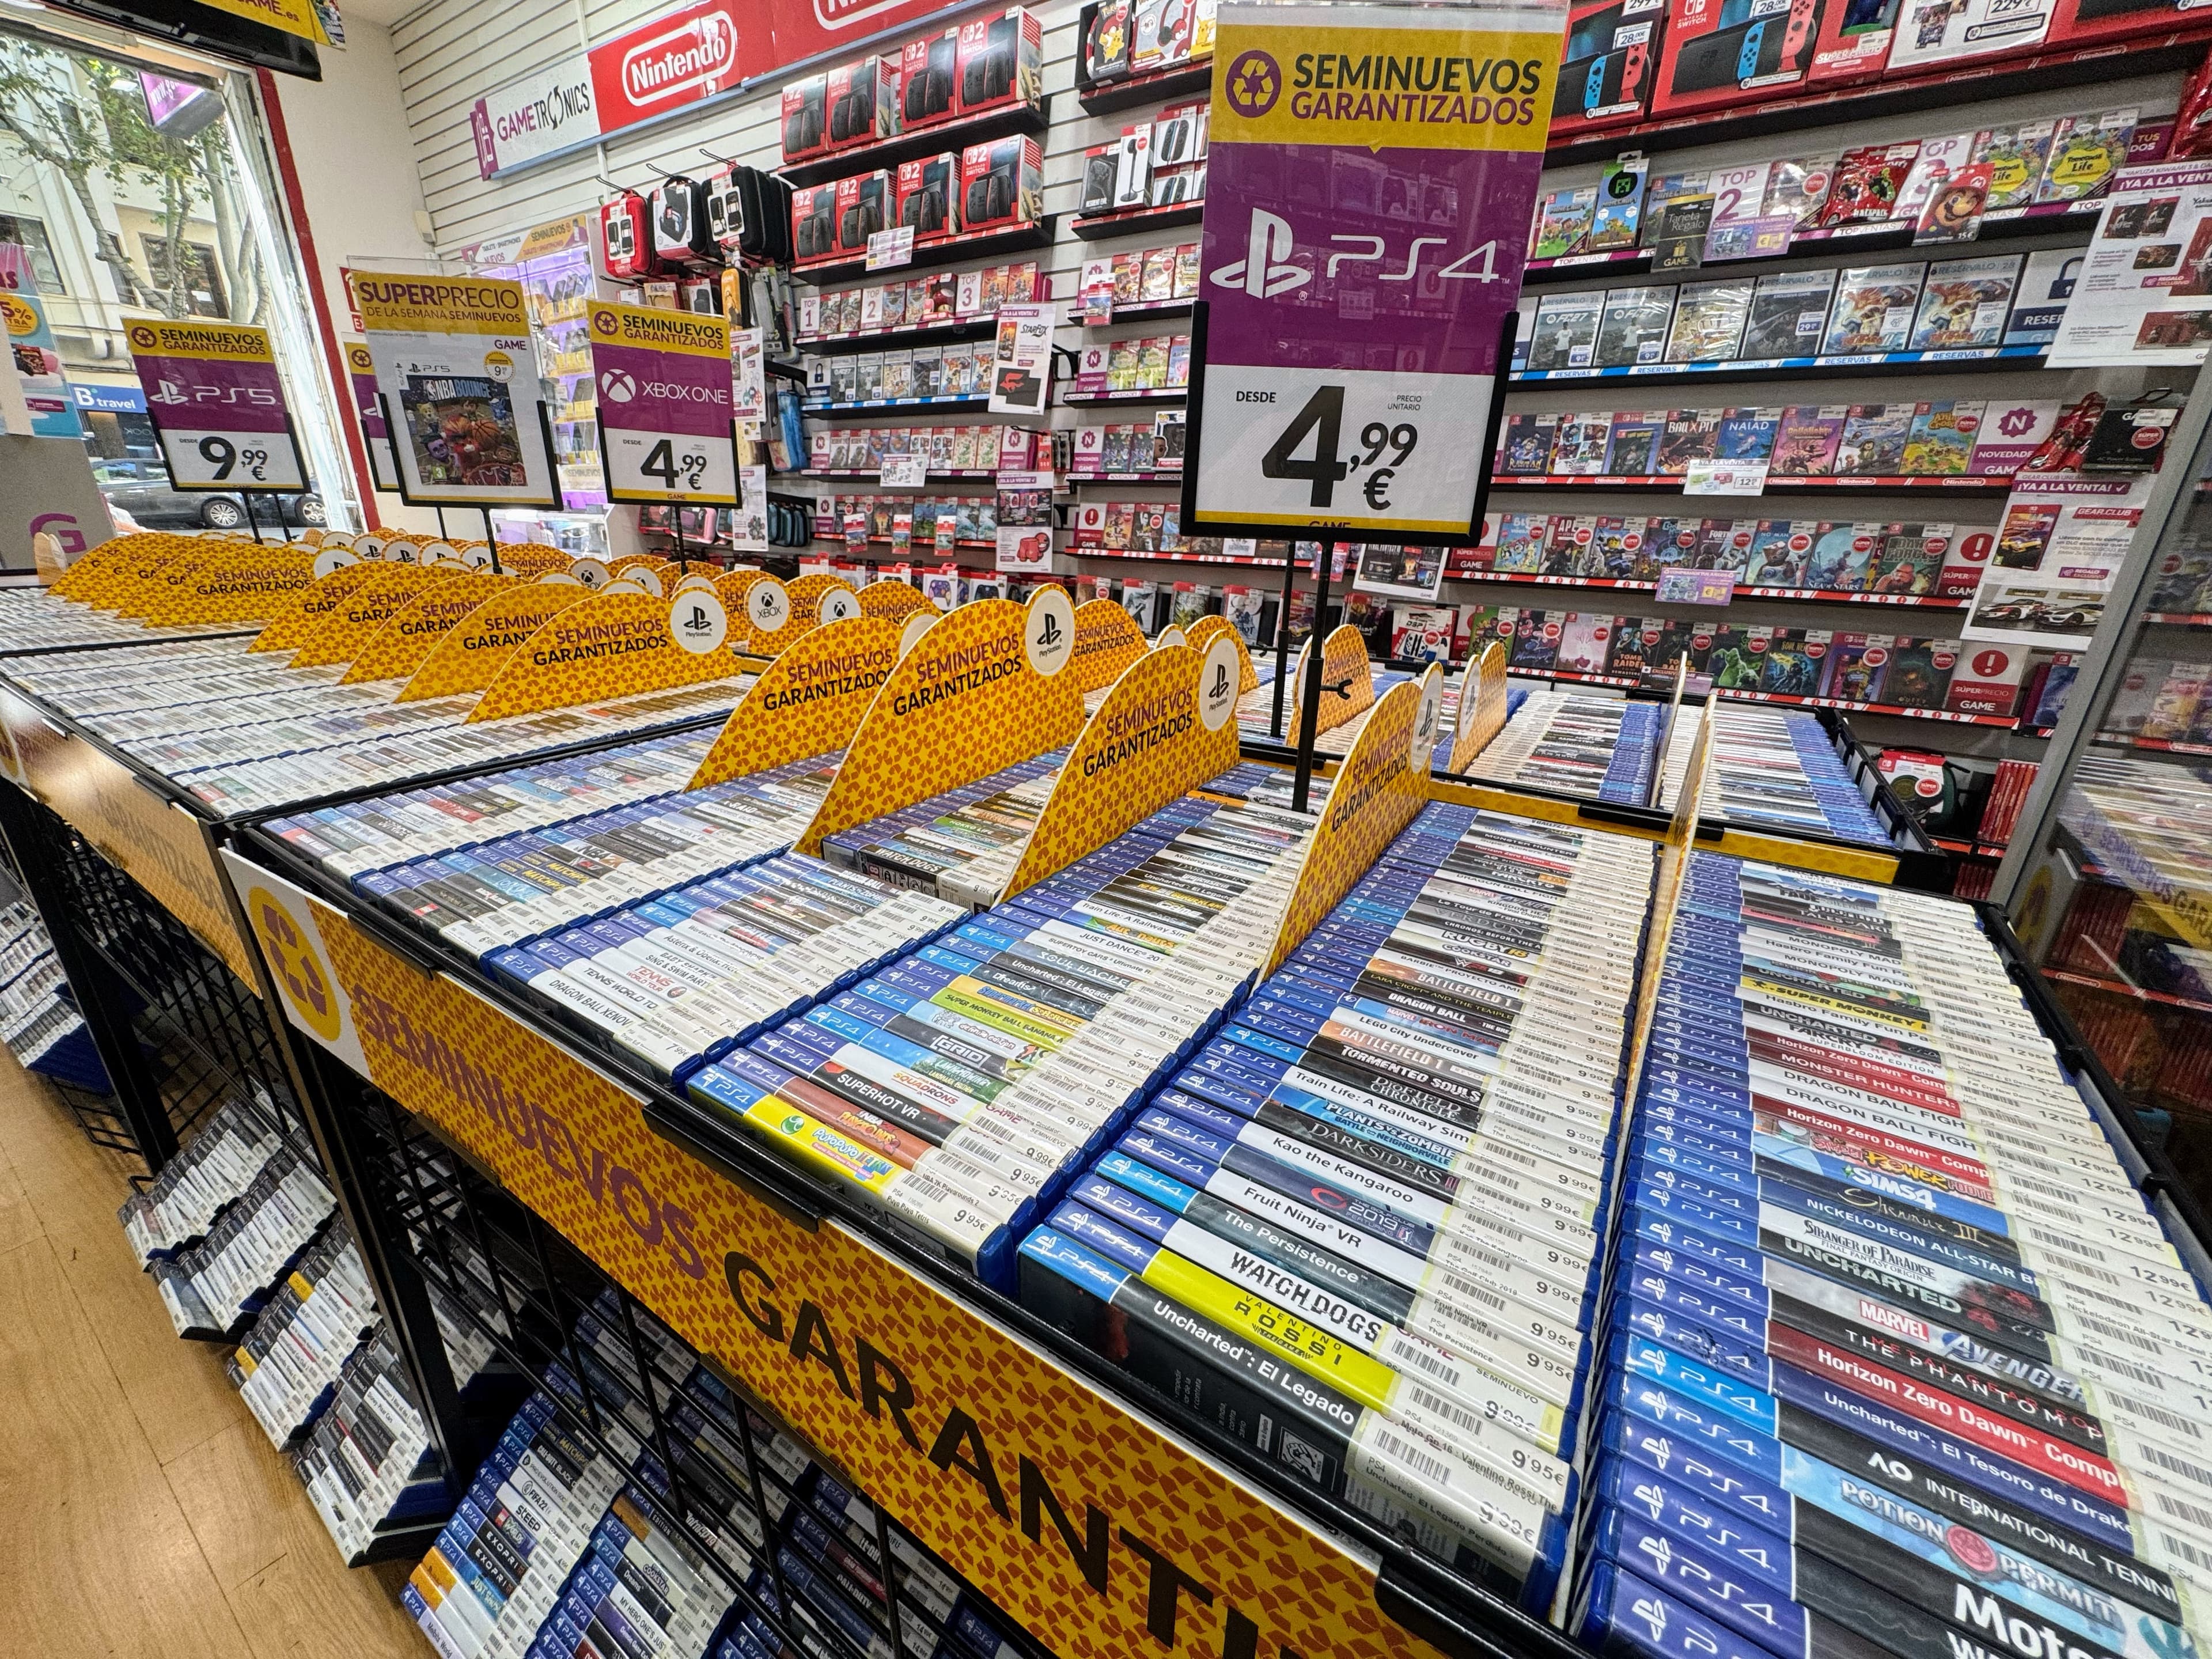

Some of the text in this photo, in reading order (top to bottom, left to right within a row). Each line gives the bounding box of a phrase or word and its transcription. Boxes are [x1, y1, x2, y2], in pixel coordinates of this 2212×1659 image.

[1676, 17, 1707, 29] SWITCH
[630, 33, 726, 92] Nintendo
[1294, 54, 1543, 94] SEMINUEVOS
[1291, 92, 1535, 126] GARANTIZADOS
[2138, 134, 2160, 142] TUS
[1720, 169, 1757, 187] TOP
[2119, 176, 2175, 190] ¡YA A LA
[1668, 211, 1700, 226] Tarjeta
[1713, 188, 1742, 221] 2
[1671, 219, 1705, 231] Regalo
[1326, 234, 1499, 283] PS4
[1559, 254, 1604, 265] TOPVENTAS
[1663, 256, 1690, 267] GAME
[358, 281, 519, 309] SUPERPRECIO
[804, 299, 816, 308] TOP
[367, 307, 521, 323] DE LA SEMANA SEMINUEVOS
[623, 315, 724, 339] SEMINUEVOS
[160, 329, 263, 346] SEMINUEVOS
[164, 341, 266, 355] GARANTIZADOS
[494, 340, 527, 350] GAME
[624, 329, 724, 350] GARANTIZADOS
[1931, 351, 1985, 359] RESERVAS
[97, 397, 136, 410] travel
[193, 385, 277, 405] PS5
[436, 379, 490, 400] NBA BOUNCE
[642, 381, 728, 404] XBOX ONE
[1236, 391, 1277, 403] DESDE
[1397, 394, 1422, 403] PRECIO
[1689, 420, 1714, 433] X PIT
[1729, 422, 1770, 430] NAIAD
[2017, 482, 2035, 491] ¡YA
[2049, 483, 2065, 491] LA
[2068, 484, 2112, 492] VENTA!
[215, 568, 308, 583] SEMINUEVOS
[1809, 581, 1859, 590] SEA STARS
[757, 605, 782, 619] XBOX
[555, 618, 664, 645] SEMINUEVOS
[533, 634, 668, 666] GARANTIZADOS
[786, 648, 893, 684] SEMINUEVOS
[916, 632, 1021, 683] SEMINUEVOS
[893, 656, 1023, 717] GARANTIZADOS
[1955, 685, 2009, 696] SÚPERPRECIO
[1105, 690, 1194, 741] SEMINUEVOS
[1960, 700, 1995, 711] GAME
[1082, 714, 1194, 778] GARANTIZADOS
[1351, 722, 1411, 789] SEMINUEVOS
[1332, 751, 1409, 833] GARANTIZADOS
[1080, 933, 1104, 946] JUST
[549, 979, 583, 1002] DRAGON
[582, 995, 603, 1013] BALL
[584, 967, 646, 1001] TENNIS WORLD
[1067, 980, 1076, 988] El
[1417, 971, 1501, 1003] BATTLEFIELD
[945, 994, 969, 1006] SUPER
[969, 1003, 1003, 1018] MONKEY
[1002, 1016, 1022, 1027] BALL
[783, 1043, 813, 1066] PS4
[941, 1039, 984, 1063] GRID
[1341, 1044, 1482, 1103] TORMENTED SOULS
[1781, 1052, 1868, 1085] MONSTER
[837, 1073, 921, 1120] SUPERHOT VR
[893, 1071, 958, 1105] SQUADRONS
[1296, 1071, 1438, 1136] Train Life: Railway
[1309, 1121, 1444, 1184] DARKSIDERS
[1272, 1137, 1414, 1203] Kao the Kangaroo
[1113, 1195, 1162, 1229] PS4
[1224, 1210, 1253, 1233] The
[1244, 1186, 1282, 1211] Fruit
[1336, 1228, 1362, 1248] VR
[1348, 1202, 1399, 1230] 2019
[1802, 1219, 1937, 1279] STRANGER PARADISE
[1806, 1198, 2016, 1279] NICKELODEON ALL-STAR
[1785, 1237, 1962, 1314] UNCHARTED
[353, 982, 1303, 1659] SEMINUEVOS GARANTI
[1234, 1301, 1342, 1366] ROSSI
[1245, 1295, 1343, 1351] VALENTINO
[1860, 1302, 1929, 1341] MARVEL
[2067, 1303, 2207, 1354] Nickelodeon All-Star Brawl
[1428, 1325, 1494, 1363] The Persistence
[1257, 1359, 1279, 1381] El
[1280, 1373, 1355, 1426] Legado
[1476, 1367, 1539, 1404] SEMINUEVO
[1680, 1365, 1759, 1412] PS4
[1817, 1346, 1897, 1395] Horizon
[1903, 1382, 1953, 1417] Zero
[1844, 1328, 2065, 1428] THE PHANTOM
[1685, 1457, 1772, 1514] PS4
[1941, 1441, 1961, 1461] El
[1964, 1451, 2036, 1492] Tesoro
[2040, 1486, 2067, 1506] de
[1926, 1478, 2098, 1566] INTERNATIONAL
[1840, 1476, 2124, 1634] POTION PERMIT
[1954, 1582, 2113, 1659] Mot
